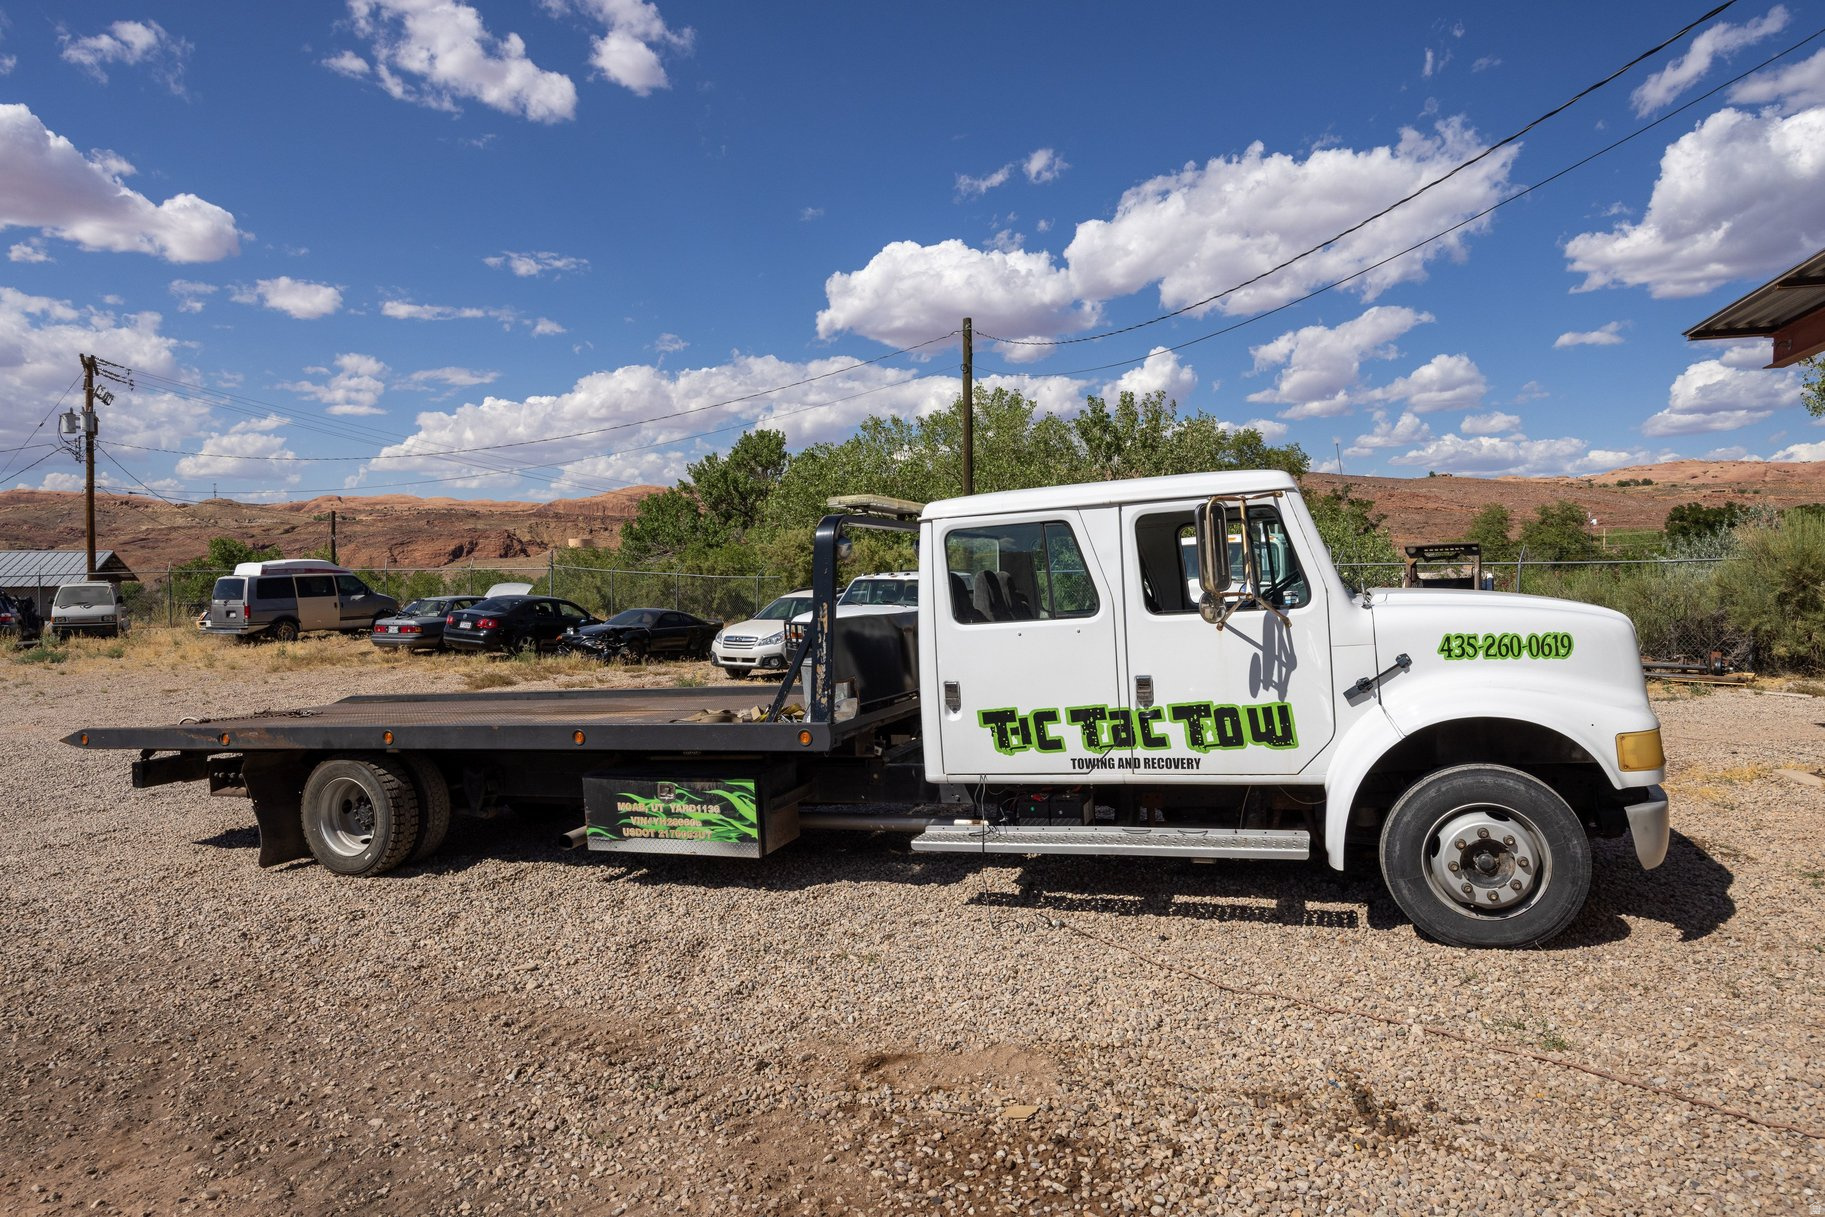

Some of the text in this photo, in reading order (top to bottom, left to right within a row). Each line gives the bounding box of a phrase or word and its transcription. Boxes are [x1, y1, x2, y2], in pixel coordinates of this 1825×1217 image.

[1439, 633, 1574, 659] 435-260-0619
[1070, 757, 1202, 770] TOWING AND RECOVERY
[651, 802, 664, 812] UT
[622, 827, 656, 838] USDOT
